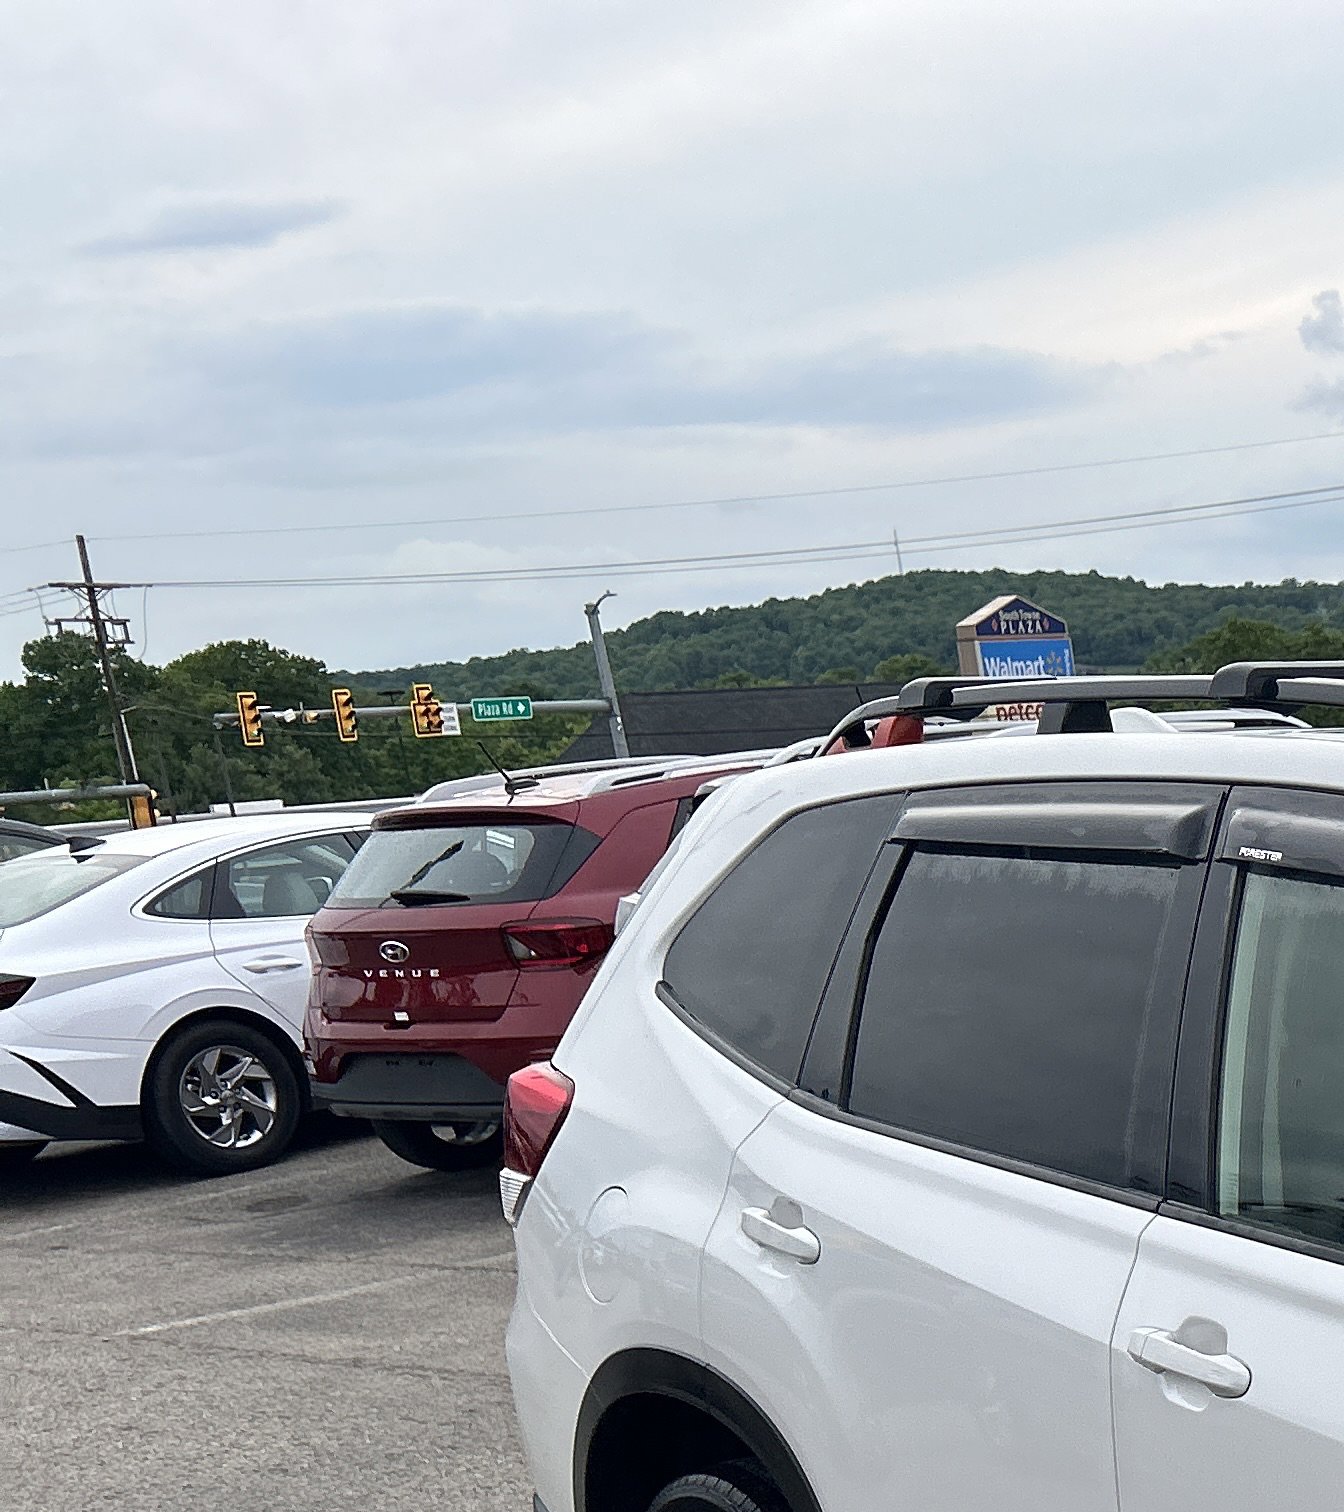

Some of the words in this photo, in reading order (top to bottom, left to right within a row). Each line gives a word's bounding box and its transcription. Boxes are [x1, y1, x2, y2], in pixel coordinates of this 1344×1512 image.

[1000, 620, 1043, 634] PLAZA
[983, 655, 1045, 677] Walmart
[478, 703, 501, 716] Plaza
[502, 702, 513, 715] Rd
[1238, 846, 1283, 862] FORESTER
[363, 969, 440, 978] VENUE
